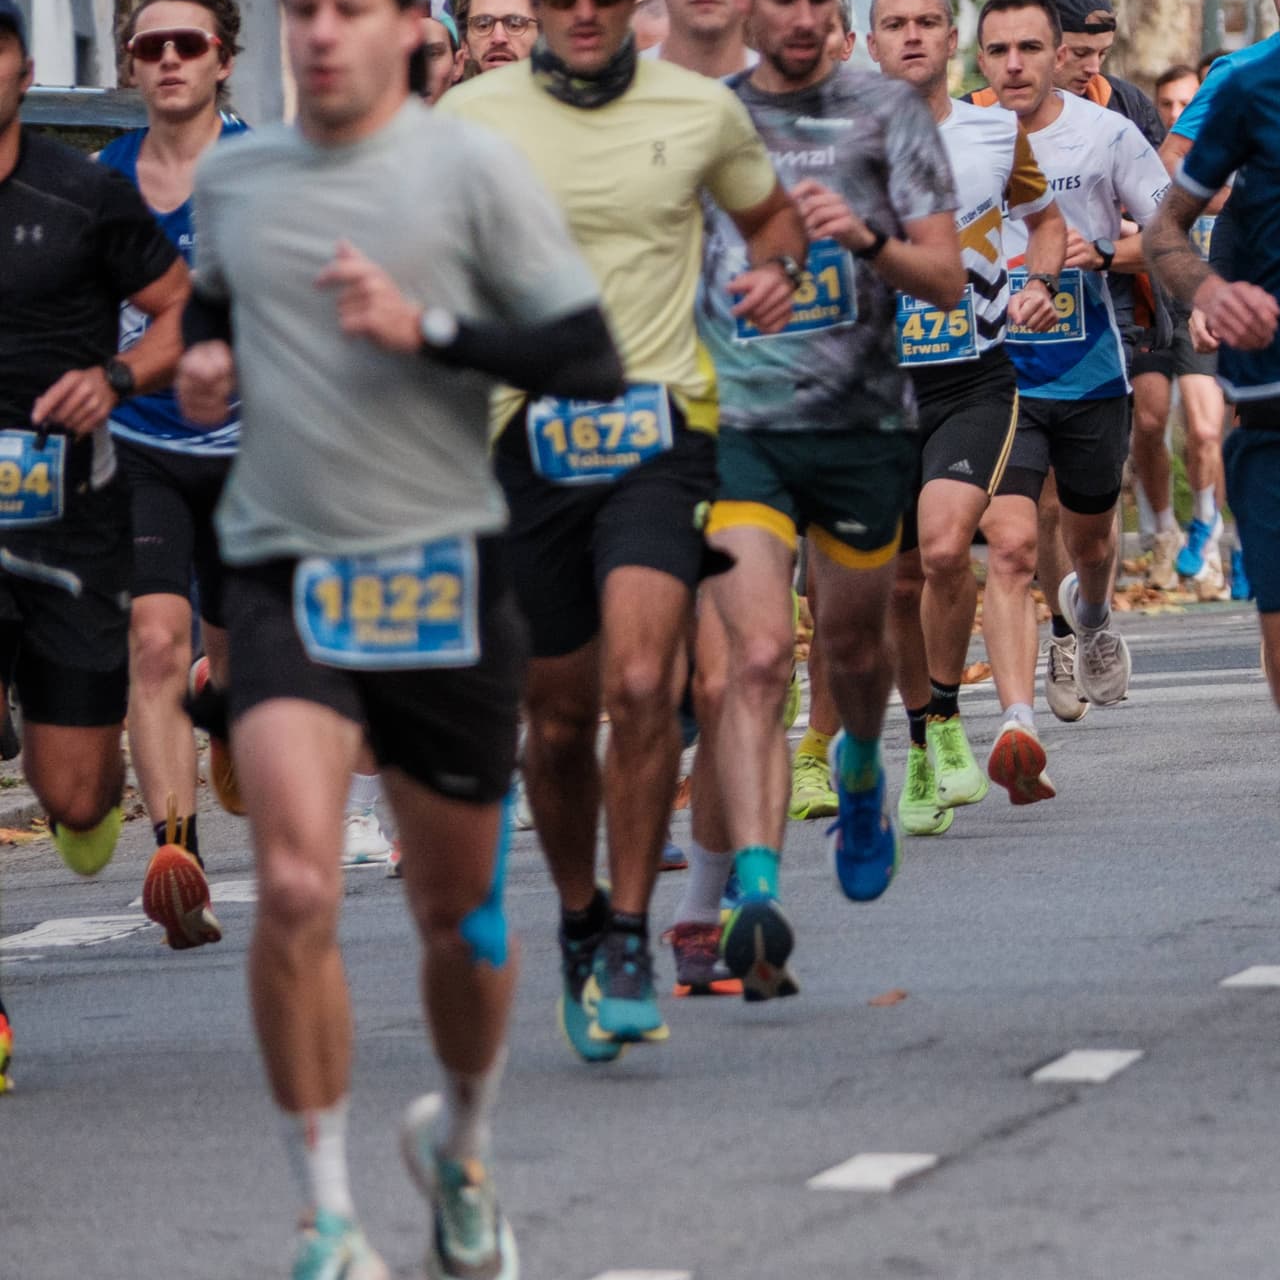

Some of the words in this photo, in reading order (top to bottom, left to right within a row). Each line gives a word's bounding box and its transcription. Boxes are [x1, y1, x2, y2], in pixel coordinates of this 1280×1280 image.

[902, 308, 969, 340] 475
[902, 342, 950, 356] Erwan
[542, 409, 660, 454] 1673
[314, 573, 461, 624] 1822
